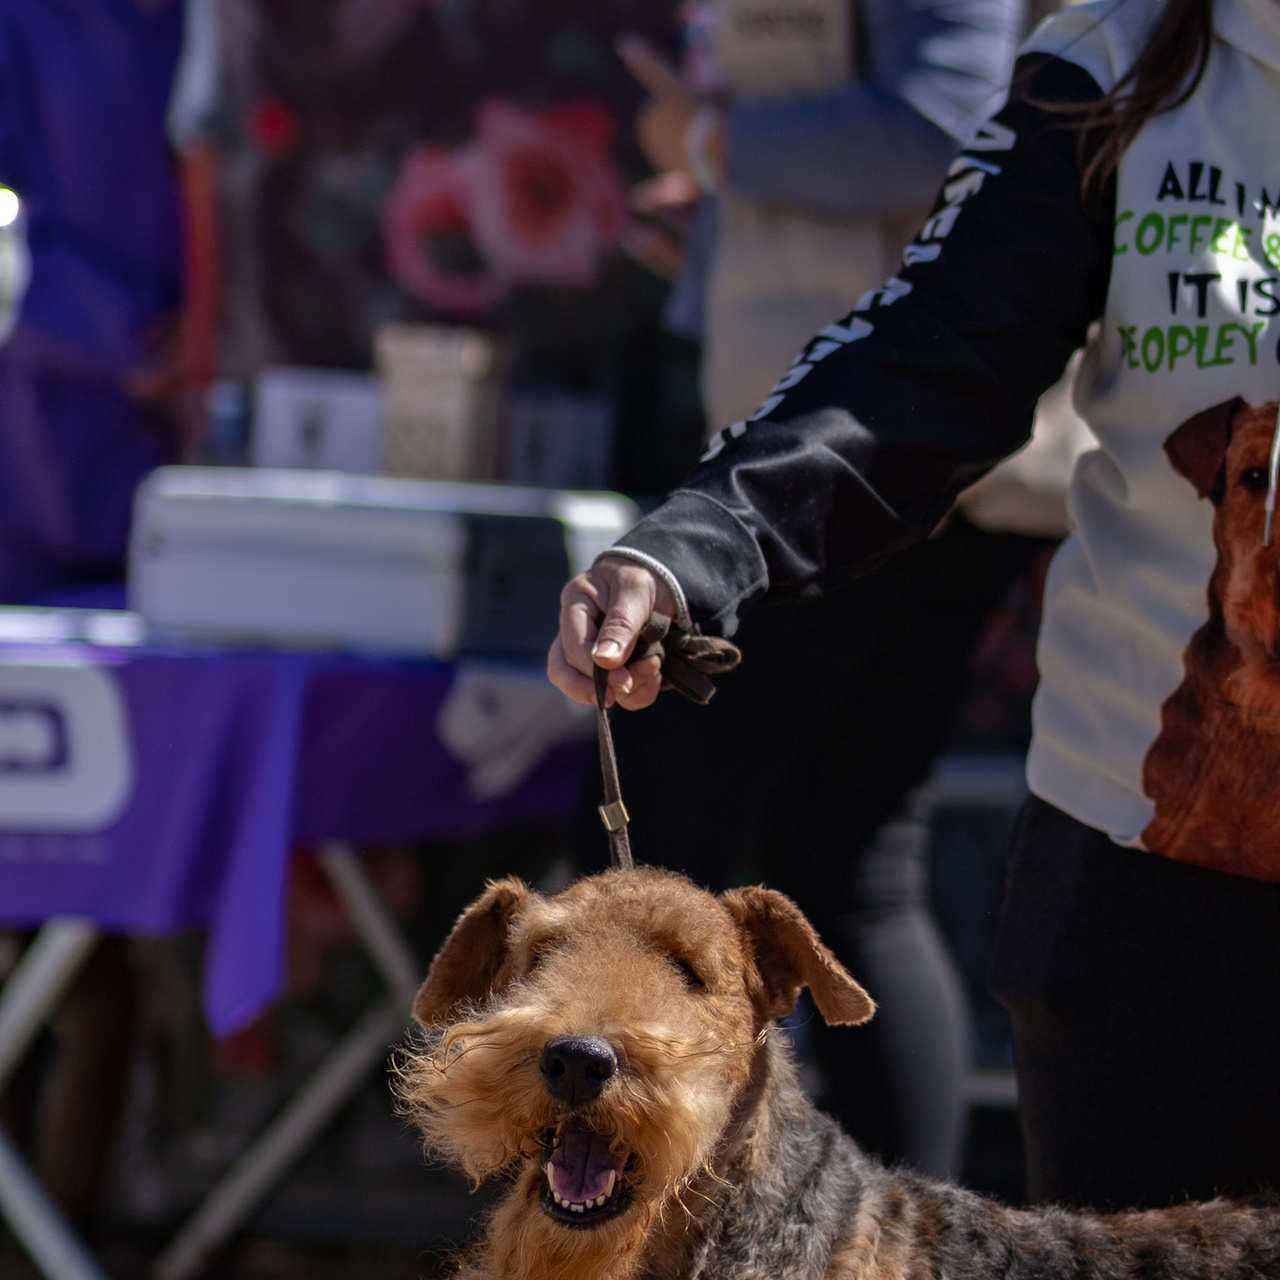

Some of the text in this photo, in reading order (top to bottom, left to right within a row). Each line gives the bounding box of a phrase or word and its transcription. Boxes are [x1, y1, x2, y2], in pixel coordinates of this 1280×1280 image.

[1157, 161, 1226, 205] ALL
[1235, 182, 1246, 217] I
[1114, 211, 1253, 261] COFFEE
[1168, 272, 1222, 319] IT
